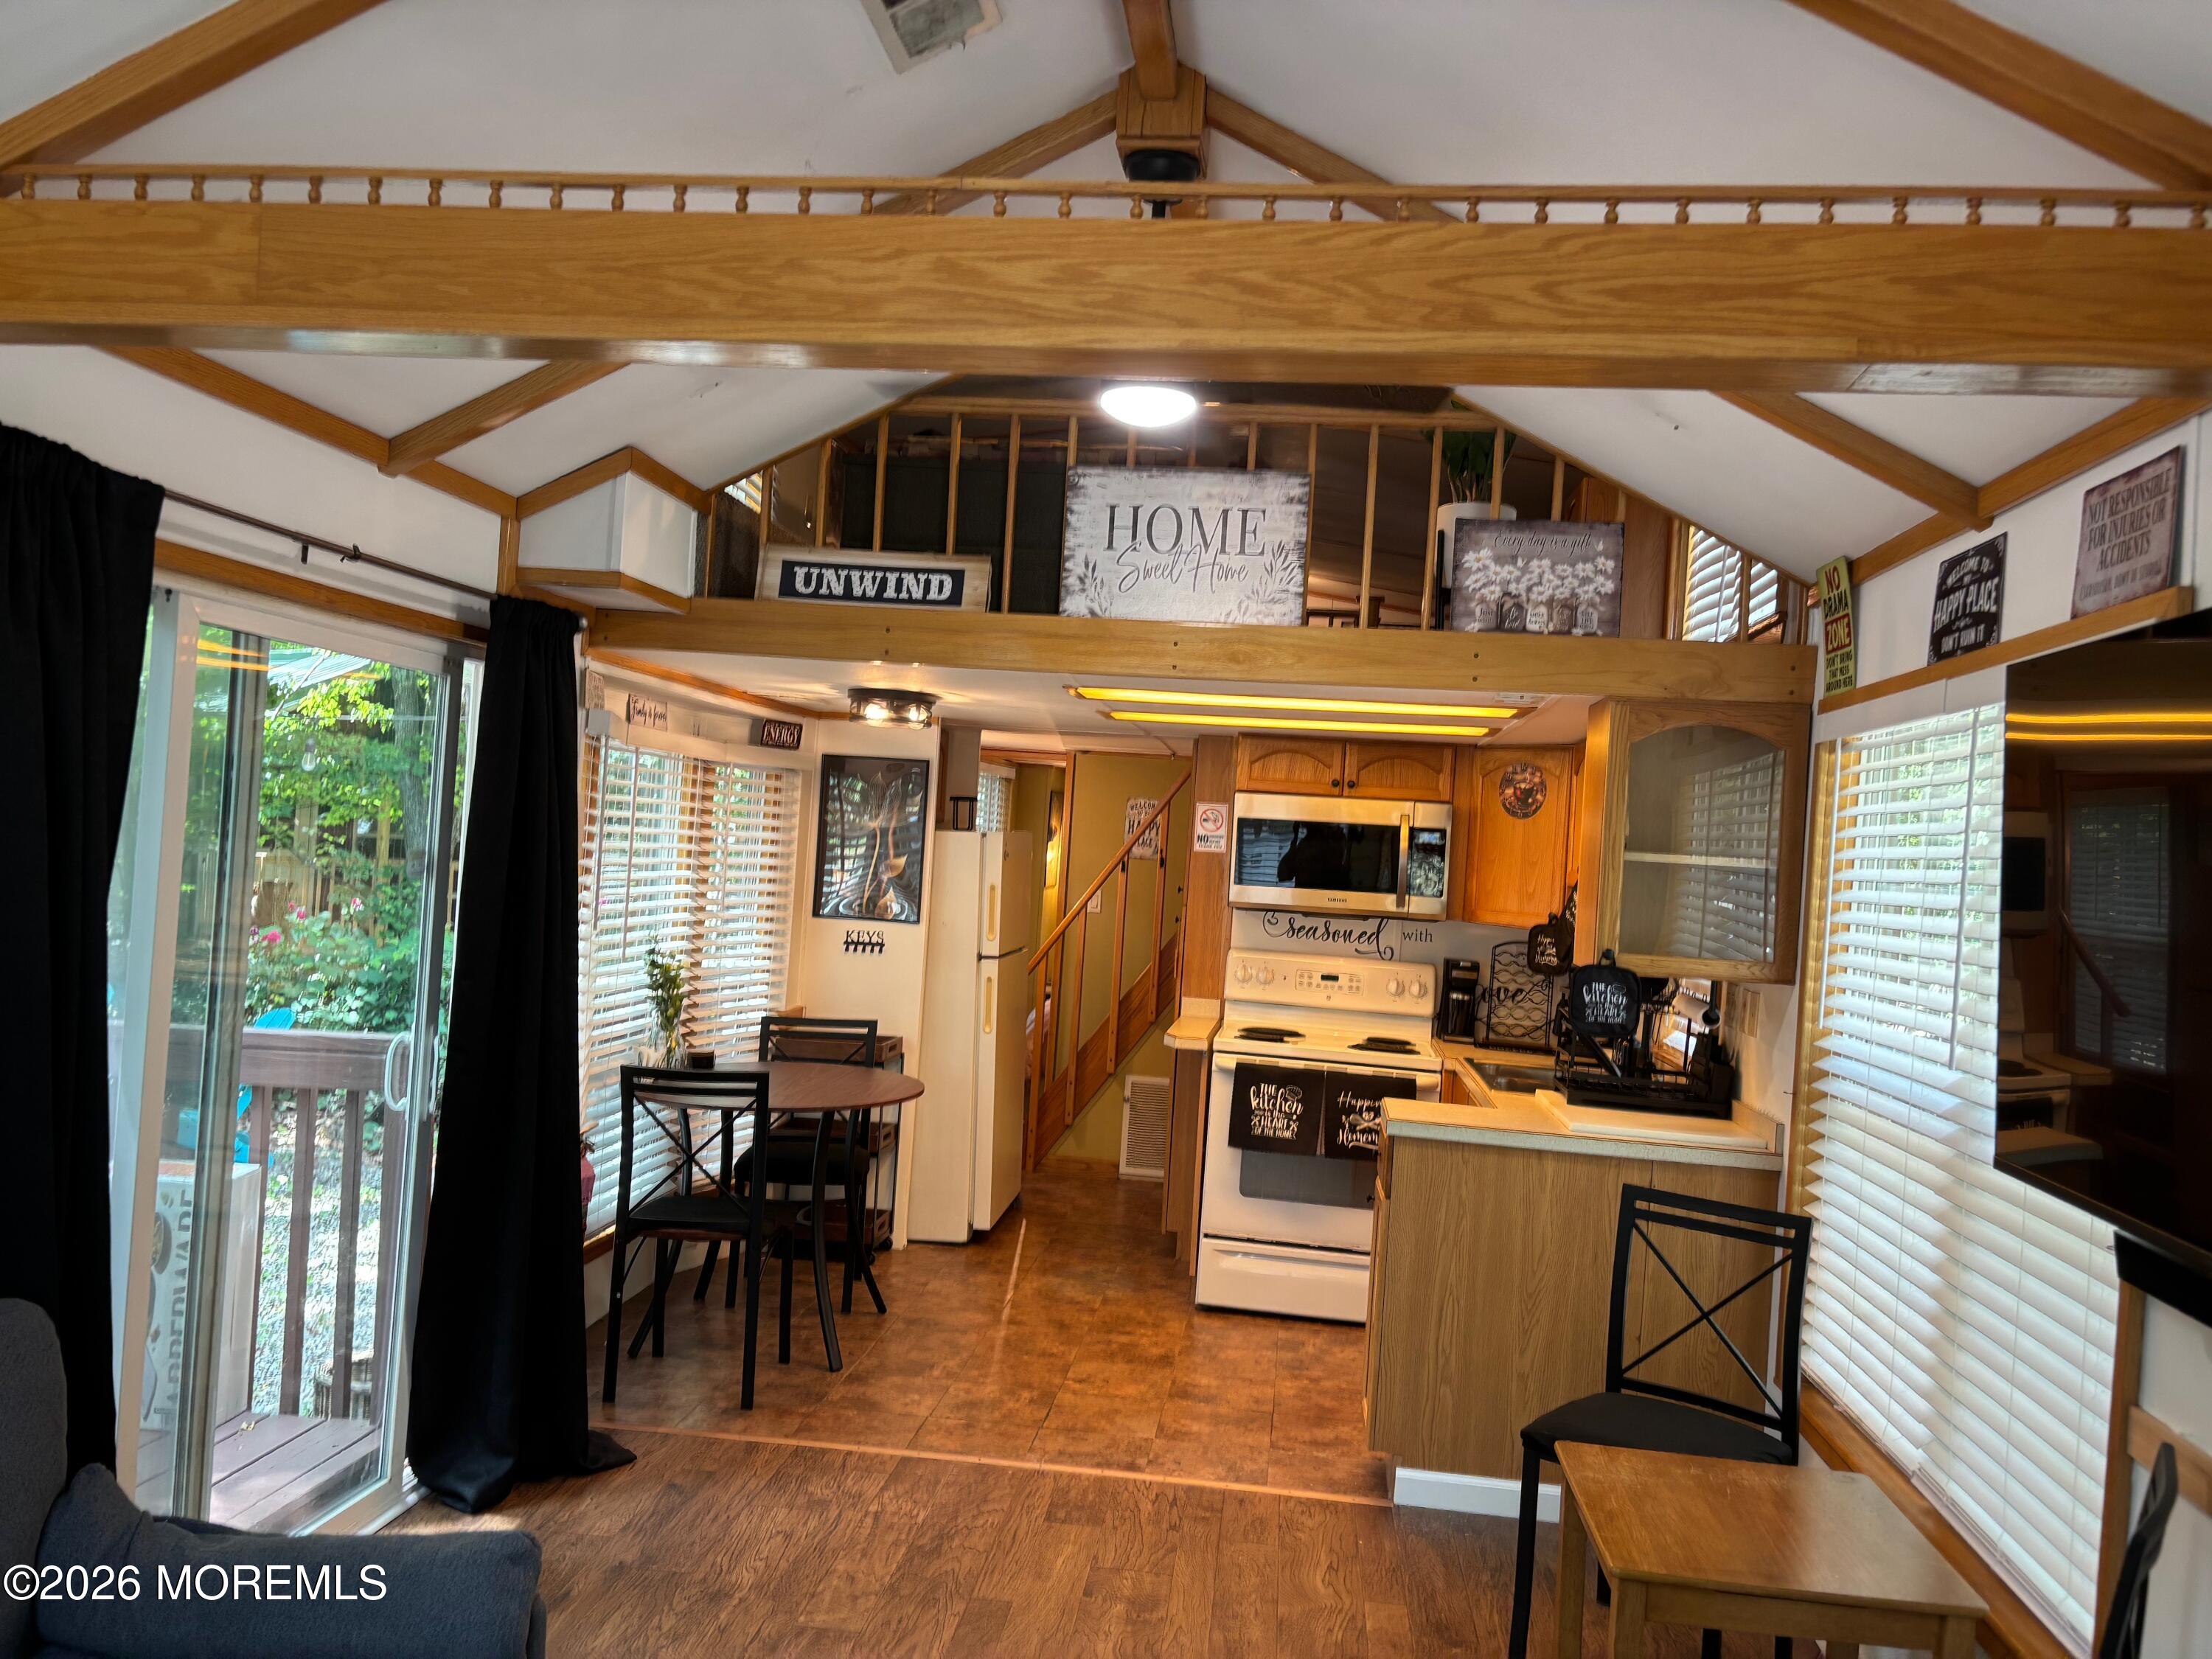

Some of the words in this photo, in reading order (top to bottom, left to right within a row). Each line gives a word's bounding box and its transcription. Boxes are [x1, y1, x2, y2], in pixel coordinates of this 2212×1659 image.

[2088, 495, 2109, 527] NOT
[2108, 467, 2172, 518] RESPONSIBLE
[1103, 503, 1266, 557] HOME
[1494, 530, 1524, 556] Every
[1527, 530, 1547, 557] day
[1550, 533, 1558, 549] is
[1560, 538, 1568, 548] a
[1568, 531, 1591, 557] gift
[2087, 521, 2107, 552] FOR
[2108, 507, 2151, 544] INJURIES
[2096, 530, 2152, 572] ACCIDENTS
[1116, 540, 1183, 593] Sweet
[1183, 543, 1249, 594] Home
[1825, 566, 1841, 595] NO
[1945, 555, 1981, 588] WELCOME
[793, 566, 953, 601] UNWIND
[1823, 588, 1848, 619] DRAMA
[1933, 588, 1966, 633] HAPPY
[1966, 577, 2000, 614] PLACE
[1826, 617, 1851, 652] ZONE
[1825, 679, 1842, 692] AROUND
[1842, 676, 1853, 689] HERE
[1129, 801, 1157, 811] WELCOM
[1197, 833, 1209, 844] NO
[845, 930, 884, 944] KEYS
[1263, 911, 1394, 961] seasoned
[1403, 928, 1433, 944] with
[1250, 1085, 1304, 1115] kitchen
[1259, 1083, 1278, 1096] THE
[1336, 1091, 1382, 1113] Happin
[1254, 1127, 1262, 1135] OF
[1264, 1127, 1274, 1137] THE
[1276, 1128, 1293, 1139] HOME
[1261, 1116, 1289, 1130] HEART
[1336, 1127, 1379, 1147] Homem
